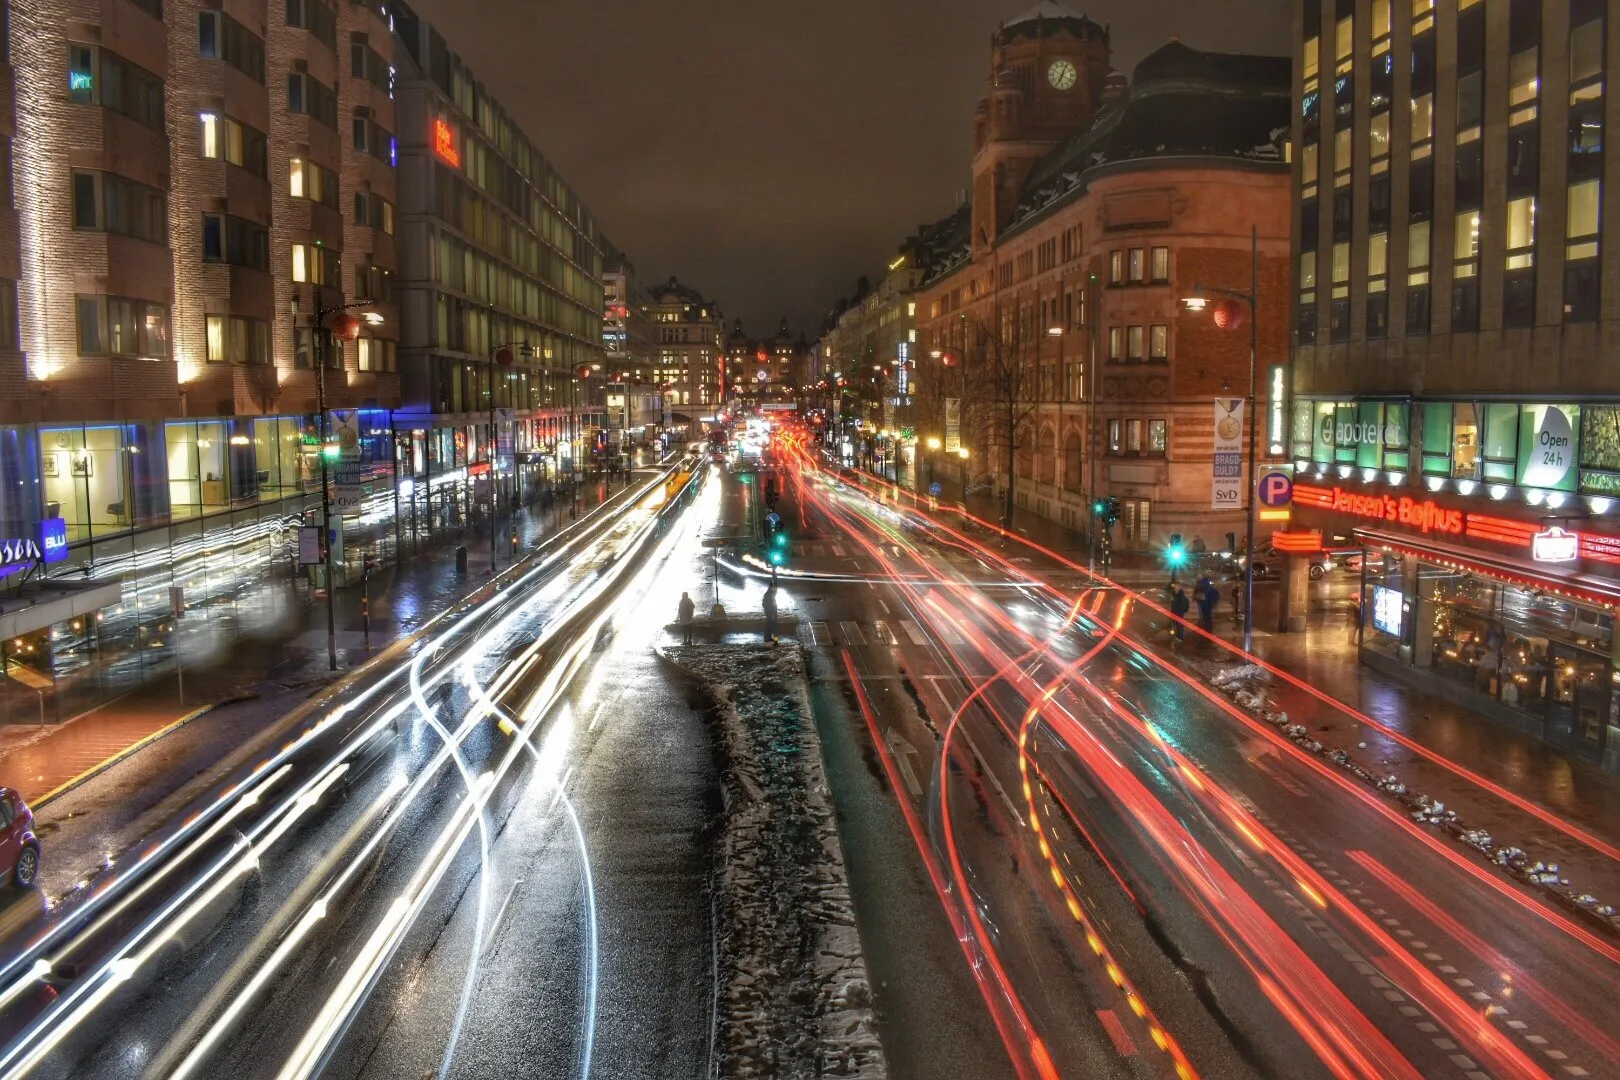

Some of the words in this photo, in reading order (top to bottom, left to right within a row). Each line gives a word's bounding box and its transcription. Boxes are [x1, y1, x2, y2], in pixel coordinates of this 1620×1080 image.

[1541, 431, 1568, 449] Open
[1215, 489, 1238, 500] SvD
[1267, 476, 1290, 504] P
[1332, 487, 1397, 521] Jensen's
[45, 534, 66, 549] BLU
